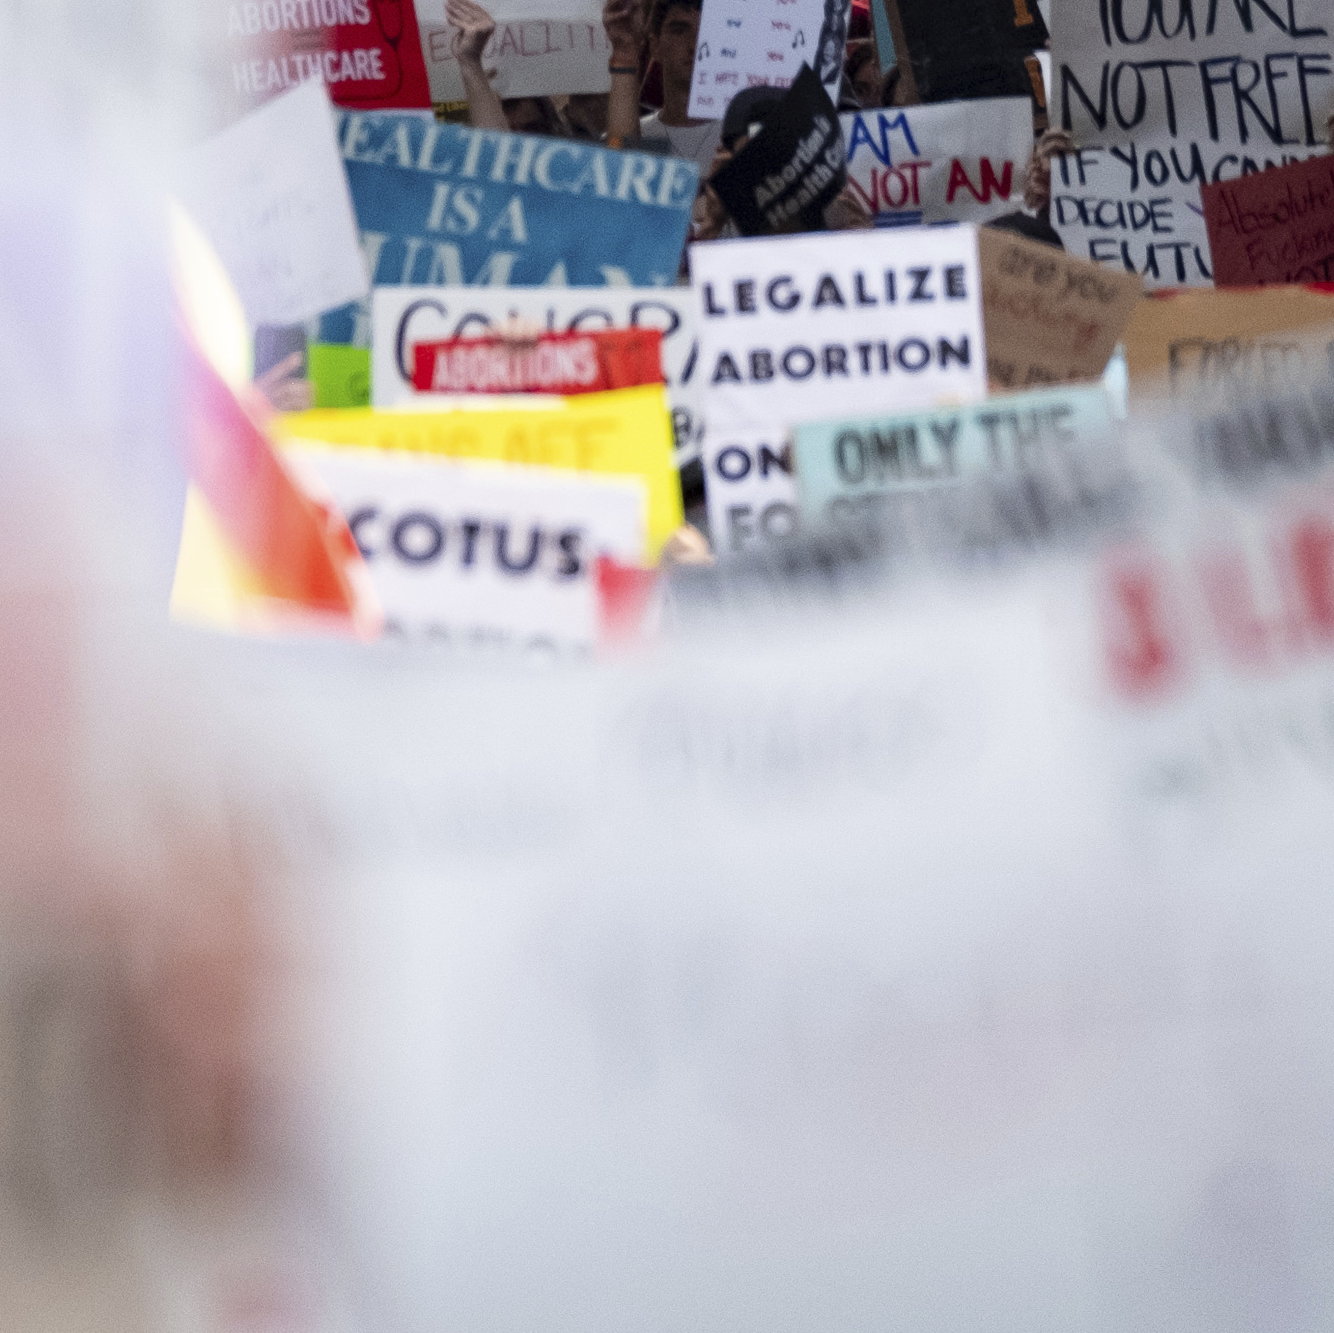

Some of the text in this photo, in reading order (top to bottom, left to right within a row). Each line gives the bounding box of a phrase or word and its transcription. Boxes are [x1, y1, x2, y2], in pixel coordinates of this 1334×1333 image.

[1059, 54, 1331, 147] NOT FREE
[946, 160, 1013, 204] AN
[1058, 143, 1204, 190] IF YOU
[426, 182, 528, 243] IS A
[1054, 196, 1173, 233] DECIDE
[703, 265, 969, 317] LEGALIZE
[433, 339, 599, 389] ABORTIONS
[711, 337, 971, 386] ABORTION
[835, 414, 962, 486] ONLY
